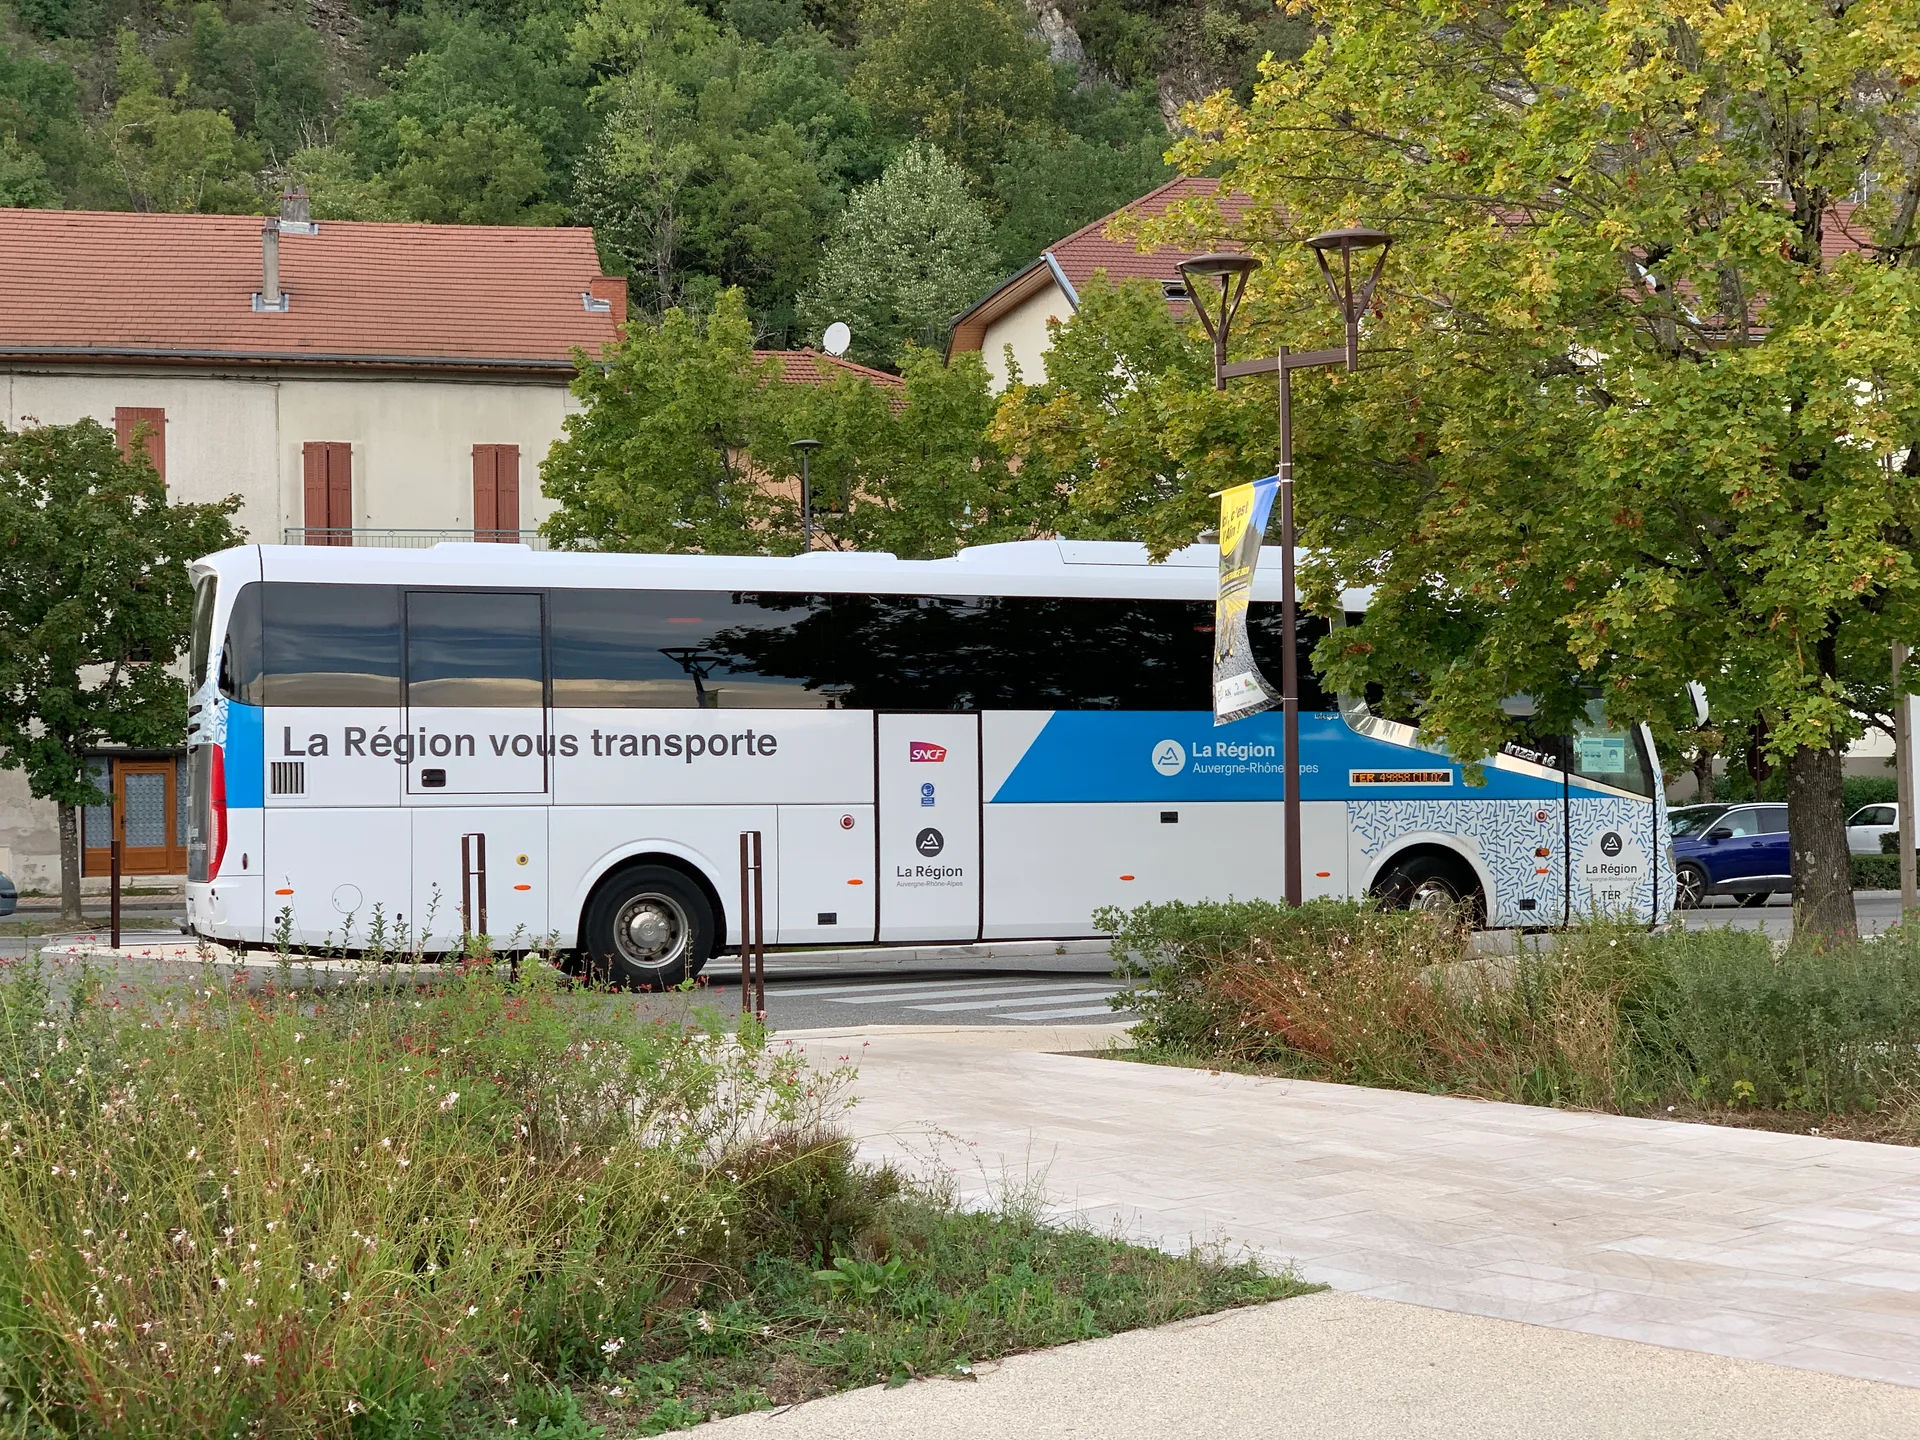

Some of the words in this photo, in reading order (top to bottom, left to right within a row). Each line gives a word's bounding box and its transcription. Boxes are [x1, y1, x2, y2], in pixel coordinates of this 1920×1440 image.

[283, 726, 329, 756] La
[344, 725, 475, 765] Région
[489, 733, 579, 757] vous
[590, 729, 777, 764] transporte
[1192, 742, 1212, 757] La
[1216, 741, 1275, 761] Région
[911, 749, 945, 760] SNCF
[1504, 741, 1541, 762] Irizar
[1541, 752, 1557, 767] i6
[1192, 762, 1319, 776] Auvergne-Rhônepes
[1352, 773, 1375, 783] TER
[896, 865, 912, 877] La
[916, 864, 963, 880] Région
[1586, 864, 1598, 874] La
[1600, 863, 1637, 876] Région
[896, 880, 964, 888] Auvergne-Rhône-Alpes
[1601, 890, 1621, 900] TER
